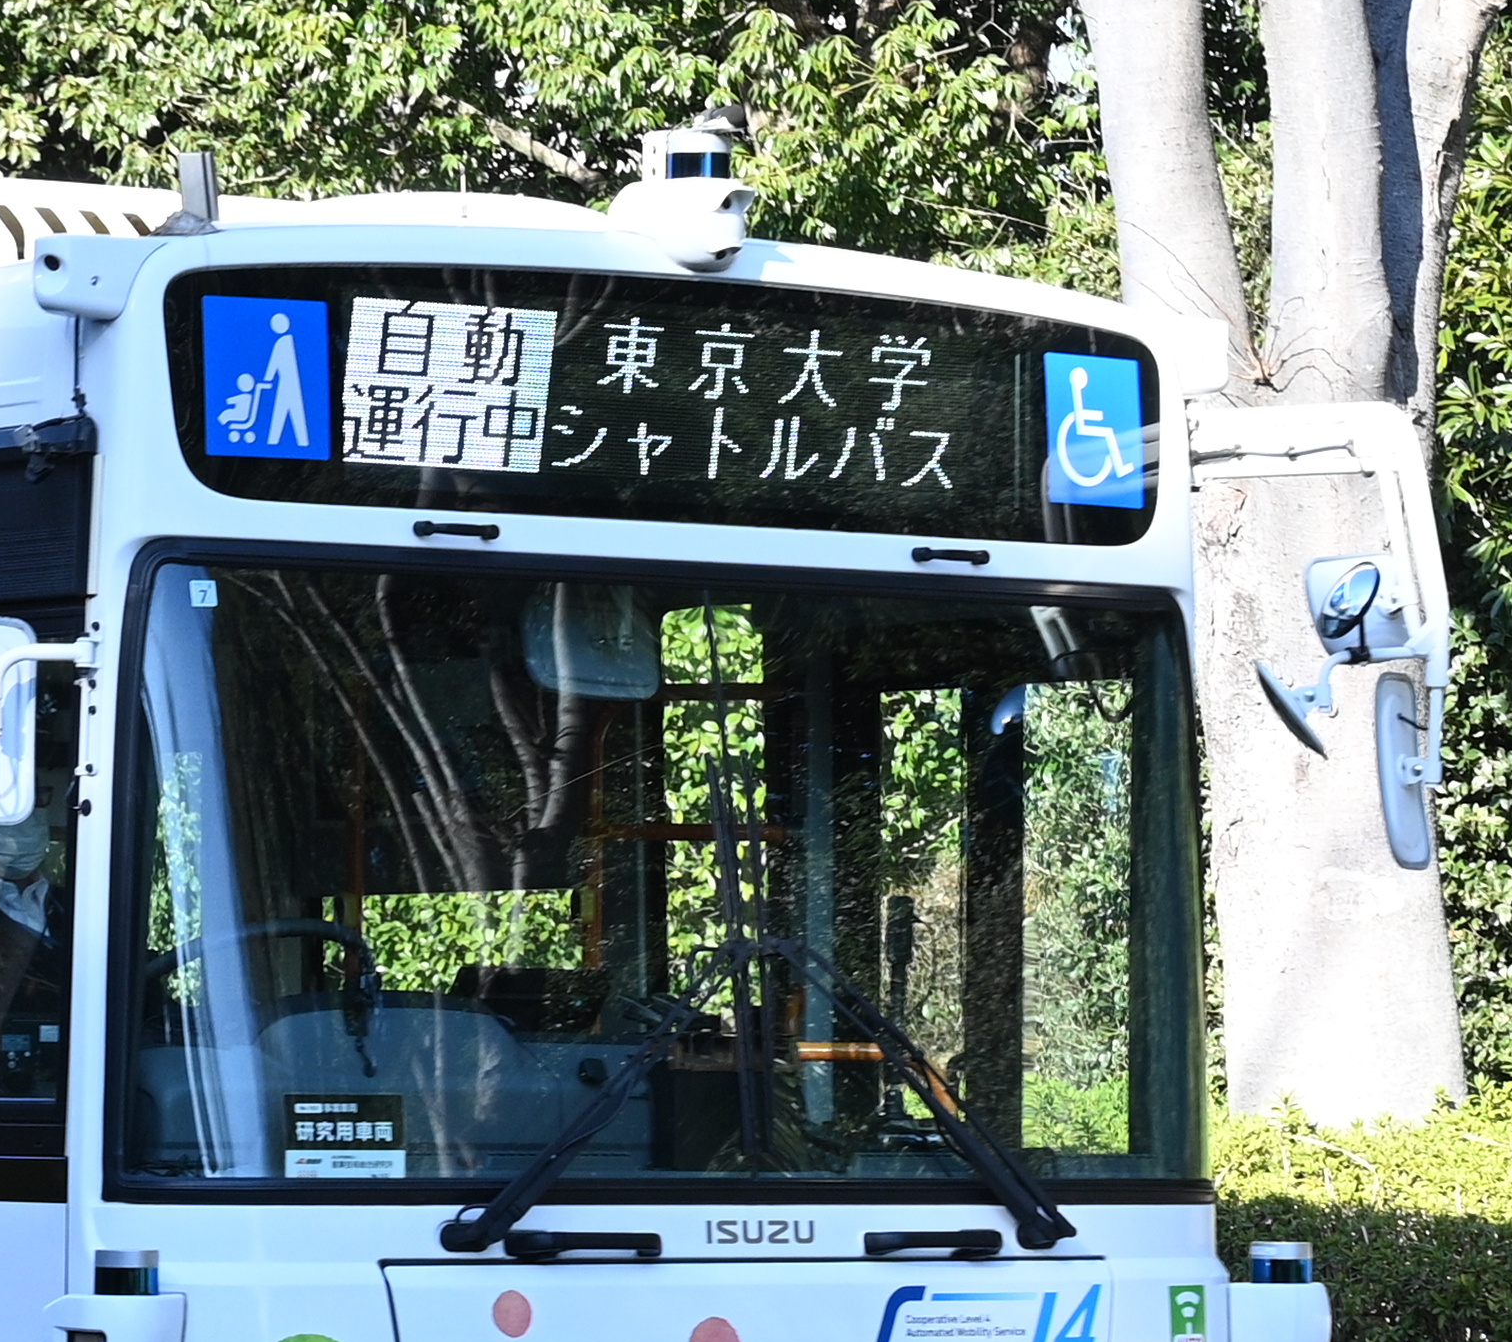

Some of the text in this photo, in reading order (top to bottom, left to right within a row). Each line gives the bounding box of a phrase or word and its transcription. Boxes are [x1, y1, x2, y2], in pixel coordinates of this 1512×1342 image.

[378, 300, 523, 387] 自動
[596, 315, 932, 411] 東京大学
[343, 382, 539, 464] 運行中
[551, 406, 954, 489] シャトルバス
[295, 1121, 394, 1142] 研究用車両
[705, 1219, 815, 1246] ISUZU
